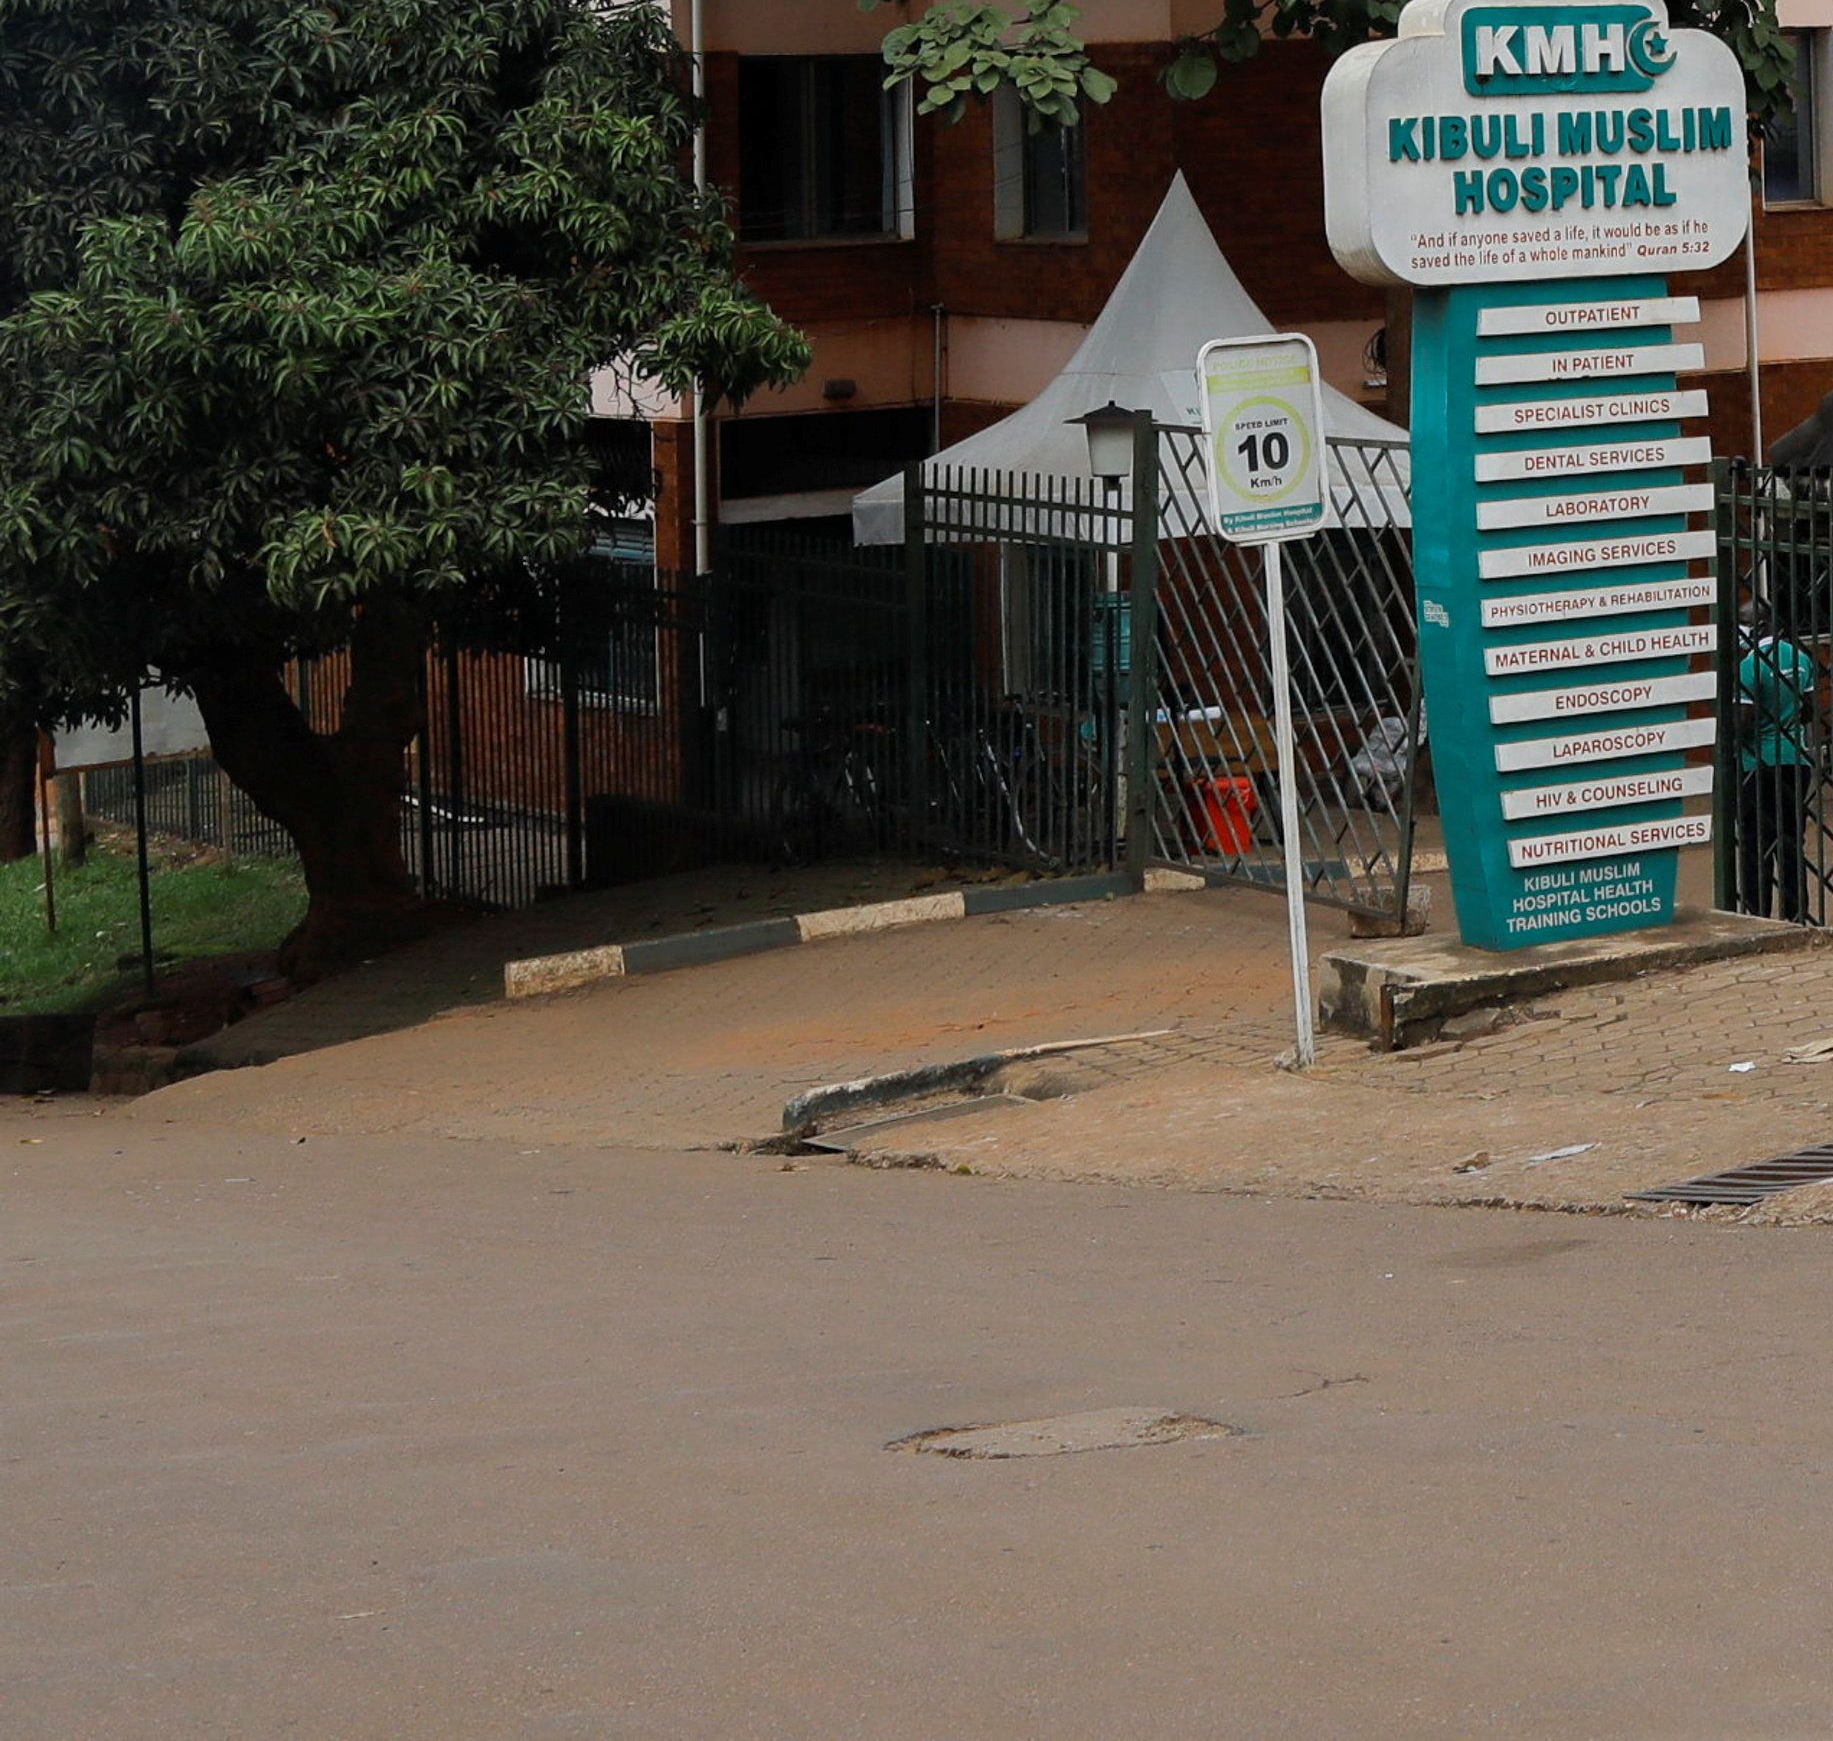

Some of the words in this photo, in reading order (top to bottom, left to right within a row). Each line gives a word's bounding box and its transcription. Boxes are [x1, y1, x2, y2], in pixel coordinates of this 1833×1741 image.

[1475, 23, 1626, 76] KMH
[1388, 113, 1546, 162] KIBULI
[1558, 107, 1733, 155] MUSLIM
[1453, 162, 1678, 216] HOSPITAL
[1449, 231, 1458, 247] if
[1460, 231, 1509, 250] anyone
[1512, 227, 1550, 244] saved
[1554, 230, 1562, 242] a
[1565, 225, 1589, 242] life,
[1592, 224, 1601, 239] it
[1604, 222, 1642, 238] would
[1645, 222, 1661, 236] be
[1664, 223, 1679, 235] as
[1682, 220, 1690, 235] if
[1693, 219, 1709, 234] he
[1411, 252, 1451, 269] saved
[1454, 250, 1476, 267] the
[1479, 249, 1499, 265] life
[1502, 248, 1516, 264] of
[1518, 251, 1527, 263] a
[1530, 245, 1568, 262] whole
[1637, 244, 1677, 257] Quran
[1682, 241, 1710, 254] 5:32
[1545, 306, 1641, 326] OUTPATIENT
[1552, 358, 1568, 373] IN
[1573, 354, 1635, 372] PATIENT
[1234, 421, 1263, 431] SPEED
[1264, 417, 1289, 428] LIMIT
[1514, 402, 1604, 424] SPECIALIST
[1609, 398, 1671, 417] CLINICS
[1237, 431, 1290, 472] 10
[1525, 452, 1585, 471] DENTAL
[1589, 447, 1666, 466] SERVICES
[1250, 475, 1283, 489] Km/h
[1546, 495, 1651, 518] LABORATORY
[1528, 548, 1596, 567] IMAGING
[1600, 540, 1677, 560] SERVICES
[1491, 597, 1596, 618] PHYSIOTHERAPY
[1599, 595, 1608, 607] &
[1610, 585, 1711, 606] REHABILITATION
[1495, 646, 1581, 668] MATERNAL
[1585, 644, 1596, 658] &
[1599, 638, 1647, 656] CHILD
[1651, 631, 1710, 651] HEALTH
[1556, 686, 1653, 710] ENDOSCOPY
[1553, 730, 1667, 758] LAPAROSCOPY
[1536, 792, 1563, 808] HIV
[1567, 791, 1578, 805] &
[1581, 777, 1684, 802] COUNSELING
[1521, 834, 1626, 860] NUTRITIONAL
[1630, 822, 1706, 845] SERVICES
[1524, 871, 1576, 893] KIBULI
[1579, 862, 1641, 885] MUSLIM
[1512, 888, 1591, 913] HOSPITAL
[1594, 879, 1654, 902] HEALTH
[1506, 908, 1582, 933] TRAINING
[1586, 896, 1663, 922] SCHOOLS
